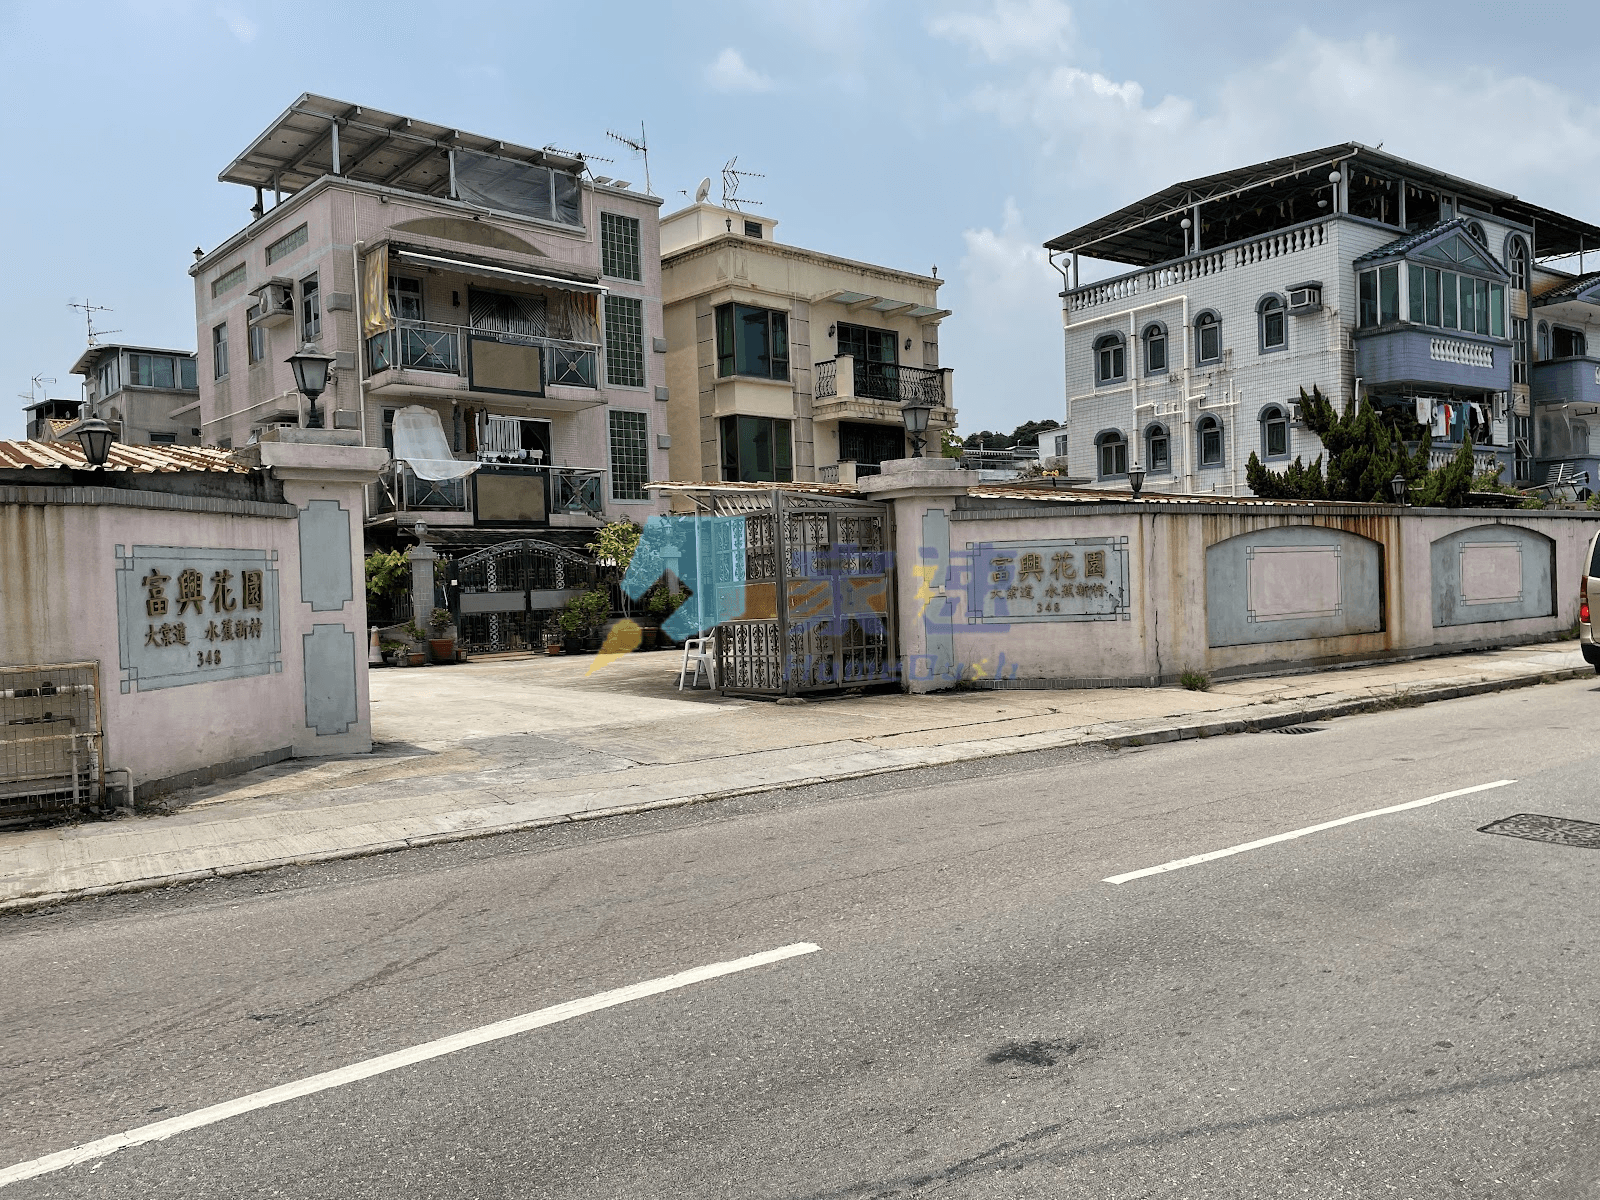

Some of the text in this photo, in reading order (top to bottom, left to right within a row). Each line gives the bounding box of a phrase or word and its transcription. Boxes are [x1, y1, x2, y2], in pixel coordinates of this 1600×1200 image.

[989, 550, 1105, 582] 富興花園
[142, 569, 264, 616] 富興花園
[1036, 602, 1060, 613] 348
[197, 649, 222, 667] 348
